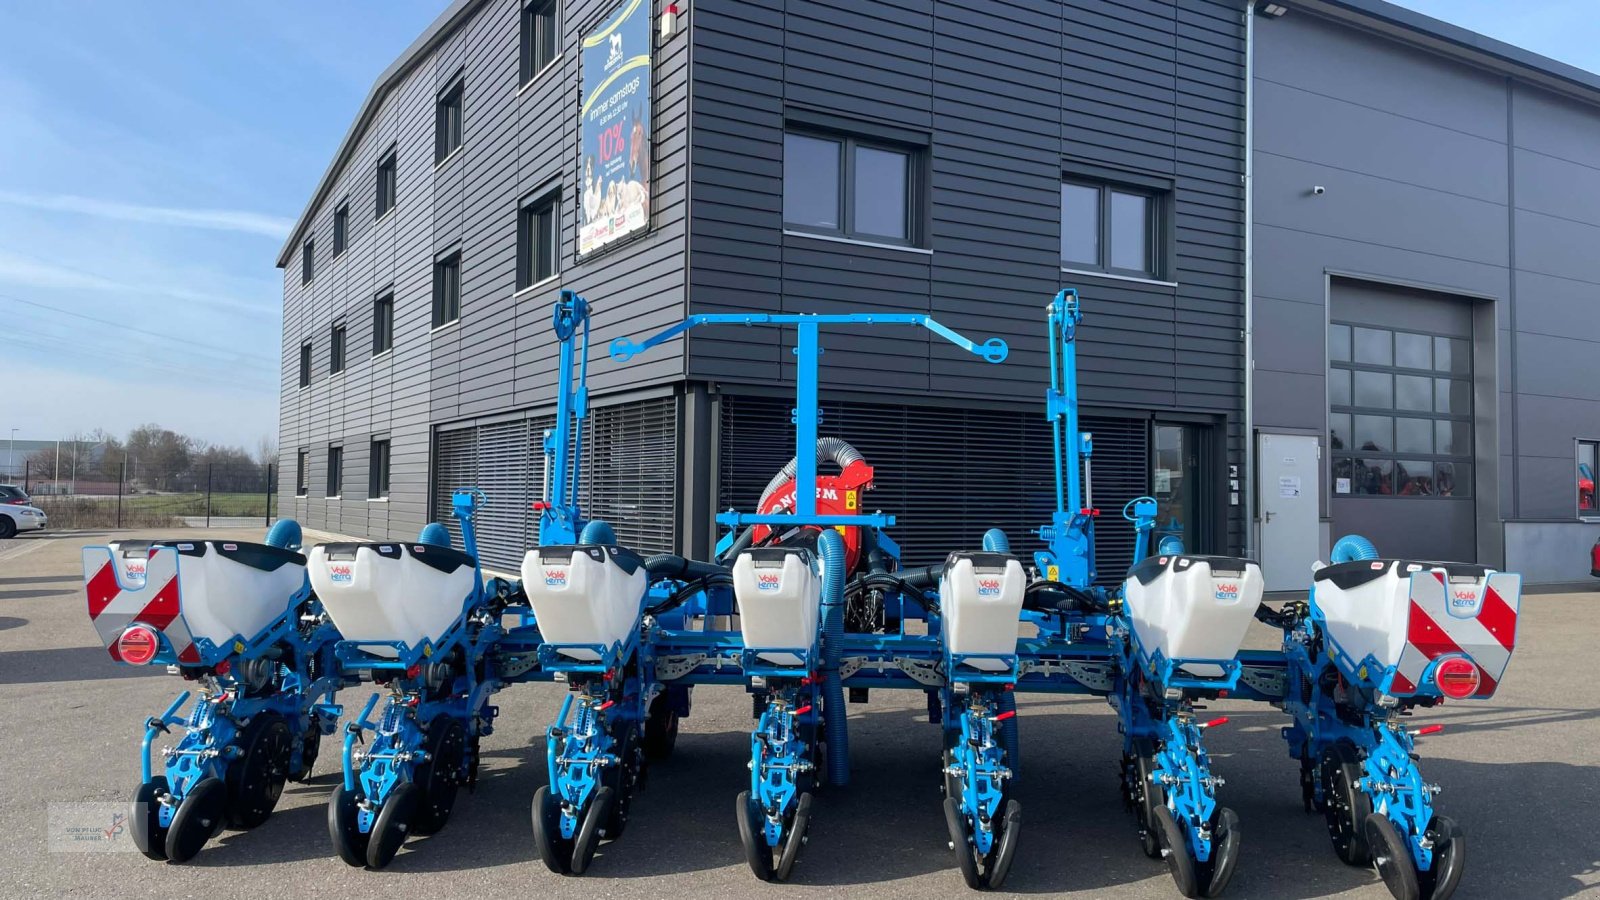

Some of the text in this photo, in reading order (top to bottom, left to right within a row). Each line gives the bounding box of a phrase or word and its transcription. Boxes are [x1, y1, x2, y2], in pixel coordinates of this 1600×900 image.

[590, 76, 640, 122] immer samstags
[598, 121, 625, 165] 10%
